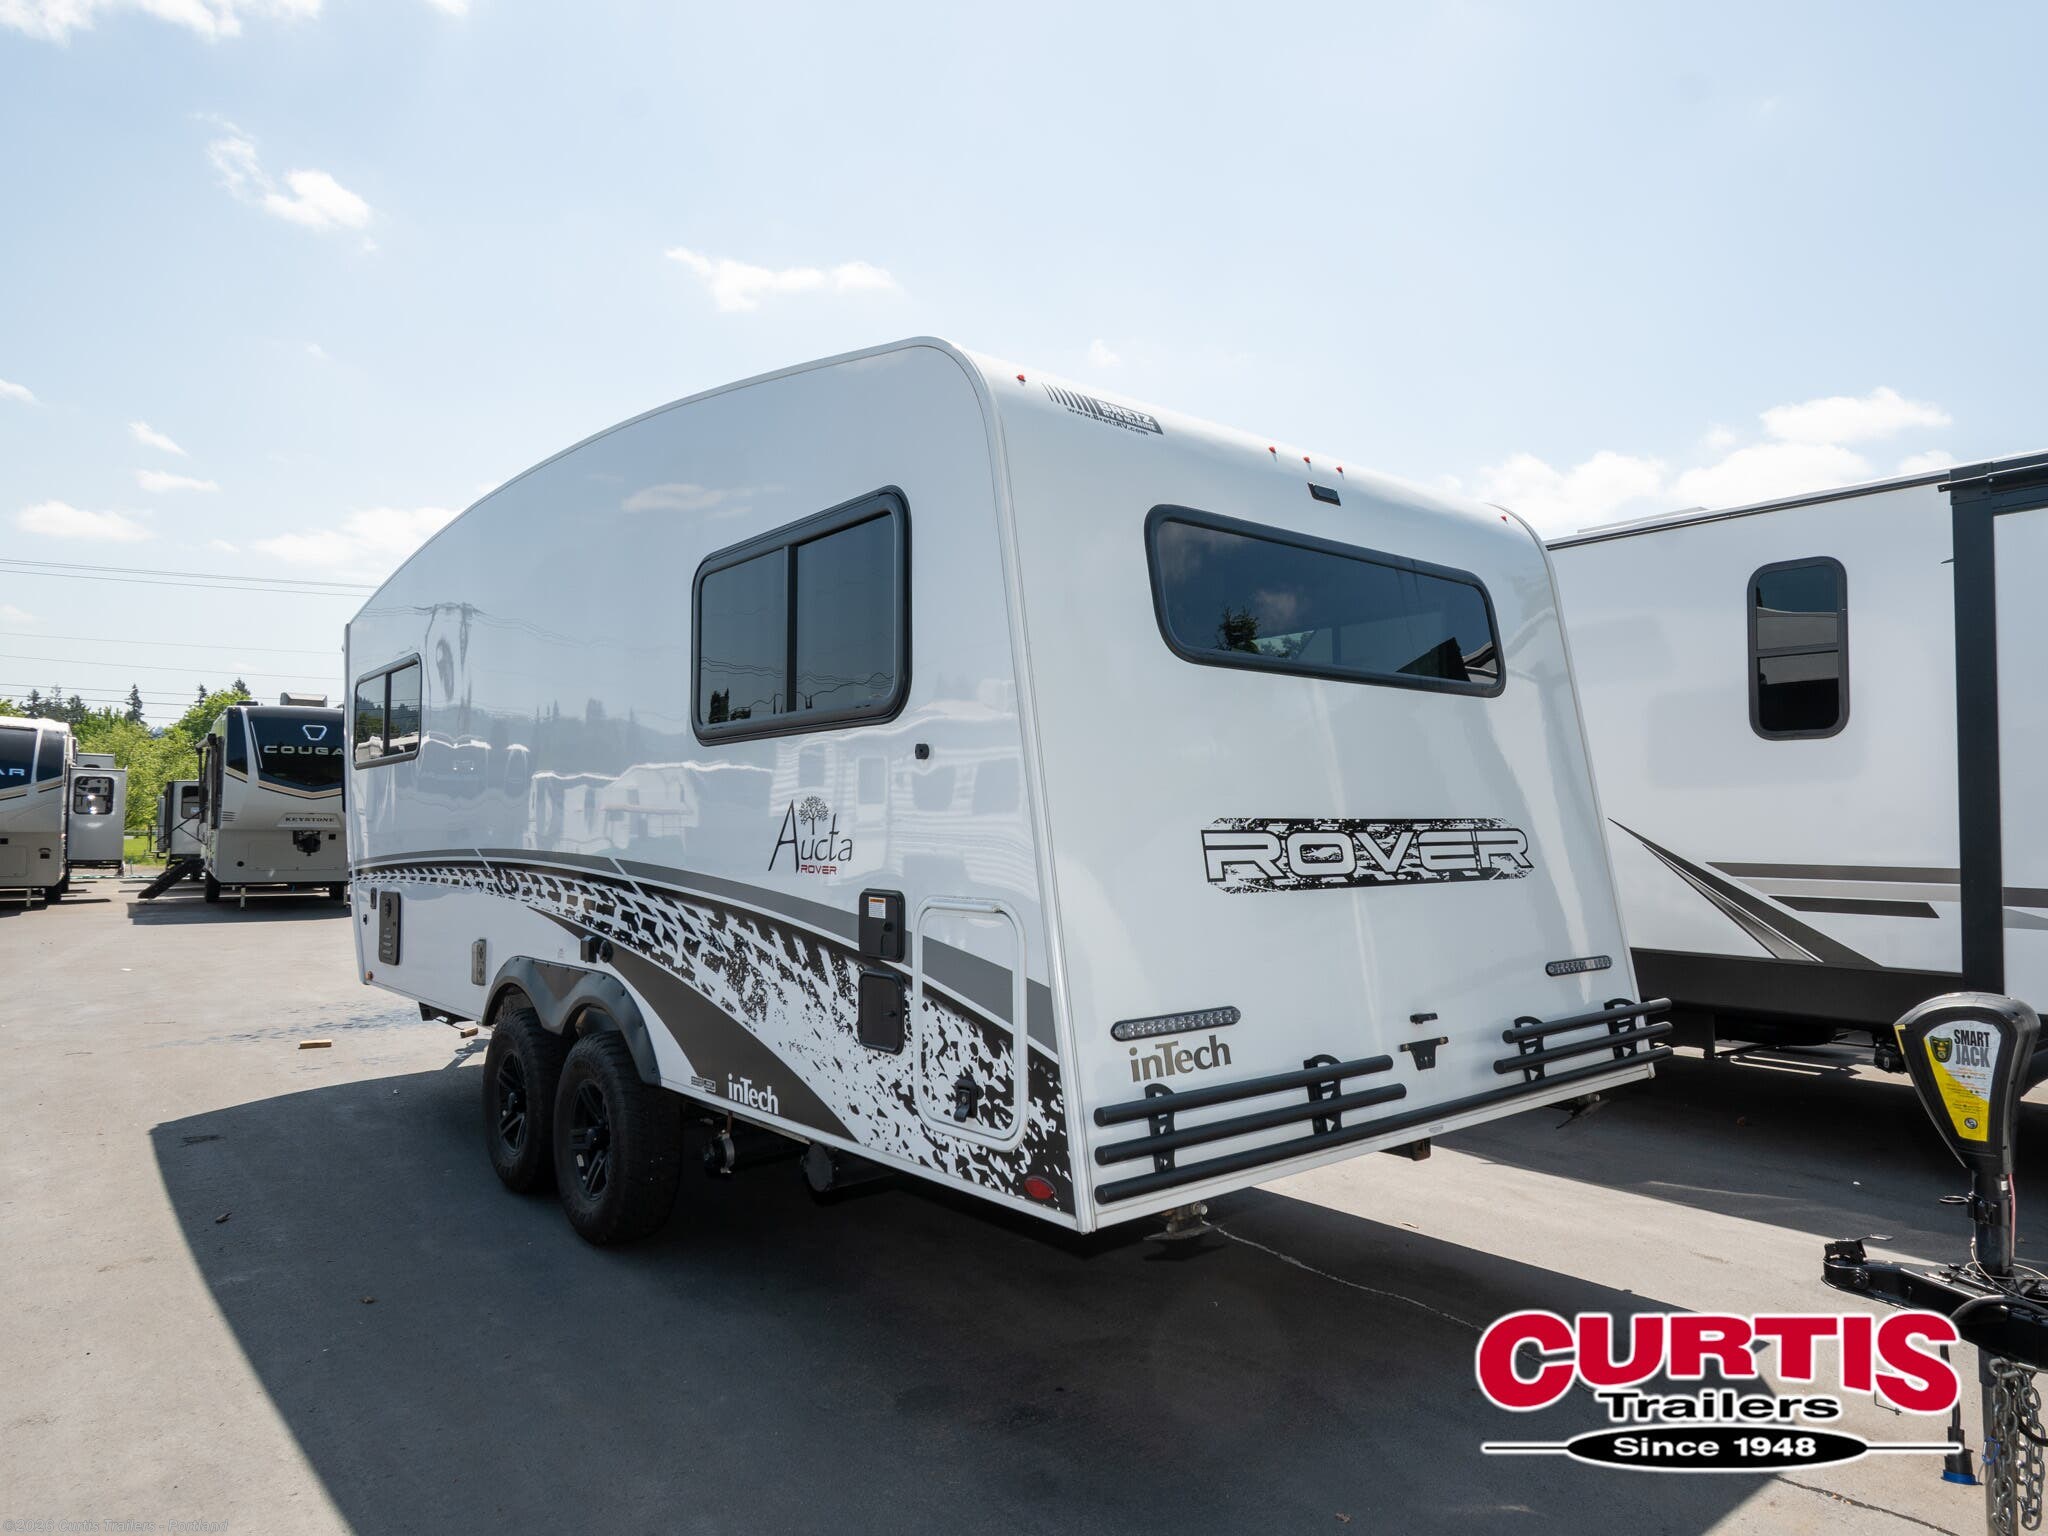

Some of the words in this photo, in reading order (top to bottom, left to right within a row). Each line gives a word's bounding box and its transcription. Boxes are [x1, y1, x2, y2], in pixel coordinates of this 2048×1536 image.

[1097, 400, 1154, 425] BRETZ
[768, 799, 852, 873] Aucta
[800, 863, 838, 875] ROVER
[1201, 828, 1533, 883] ROVER
[1954, 1029, 1991, 1048] SMART
[1129, 1035, 1232, 1083] inTech
[1955, 1046, 1991, 1068] JACK
[728, 1072, 779, 1115] inTech
